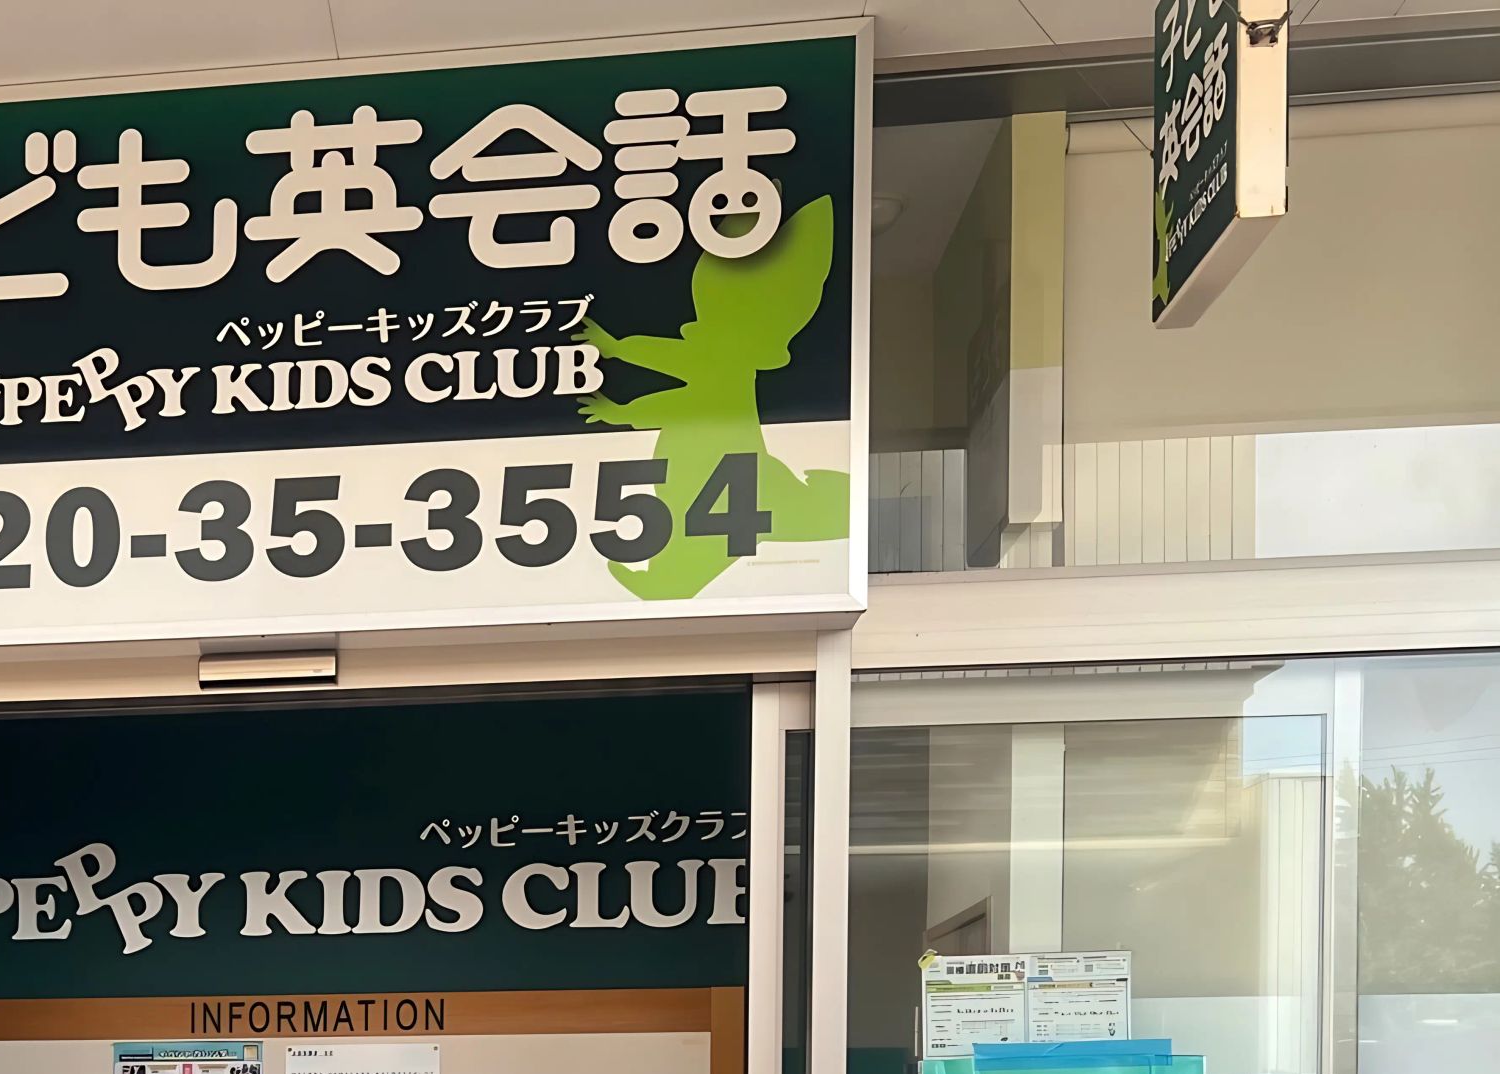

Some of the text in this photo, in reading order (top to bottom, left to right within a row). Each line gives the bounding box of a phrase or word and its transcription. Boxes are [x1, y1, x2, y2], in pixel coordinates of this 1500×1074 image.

[1160, 22, 1228, 200] 英会話
[216, 294, 596, 348] ペッピーキッズクラブ
[211, 357, 398, 414] KIDS
[404, 341, 604, 402] CLUB
[240, 866, 484, 937] KIDS
[190, 997, 447, 1034] INFORMATION
